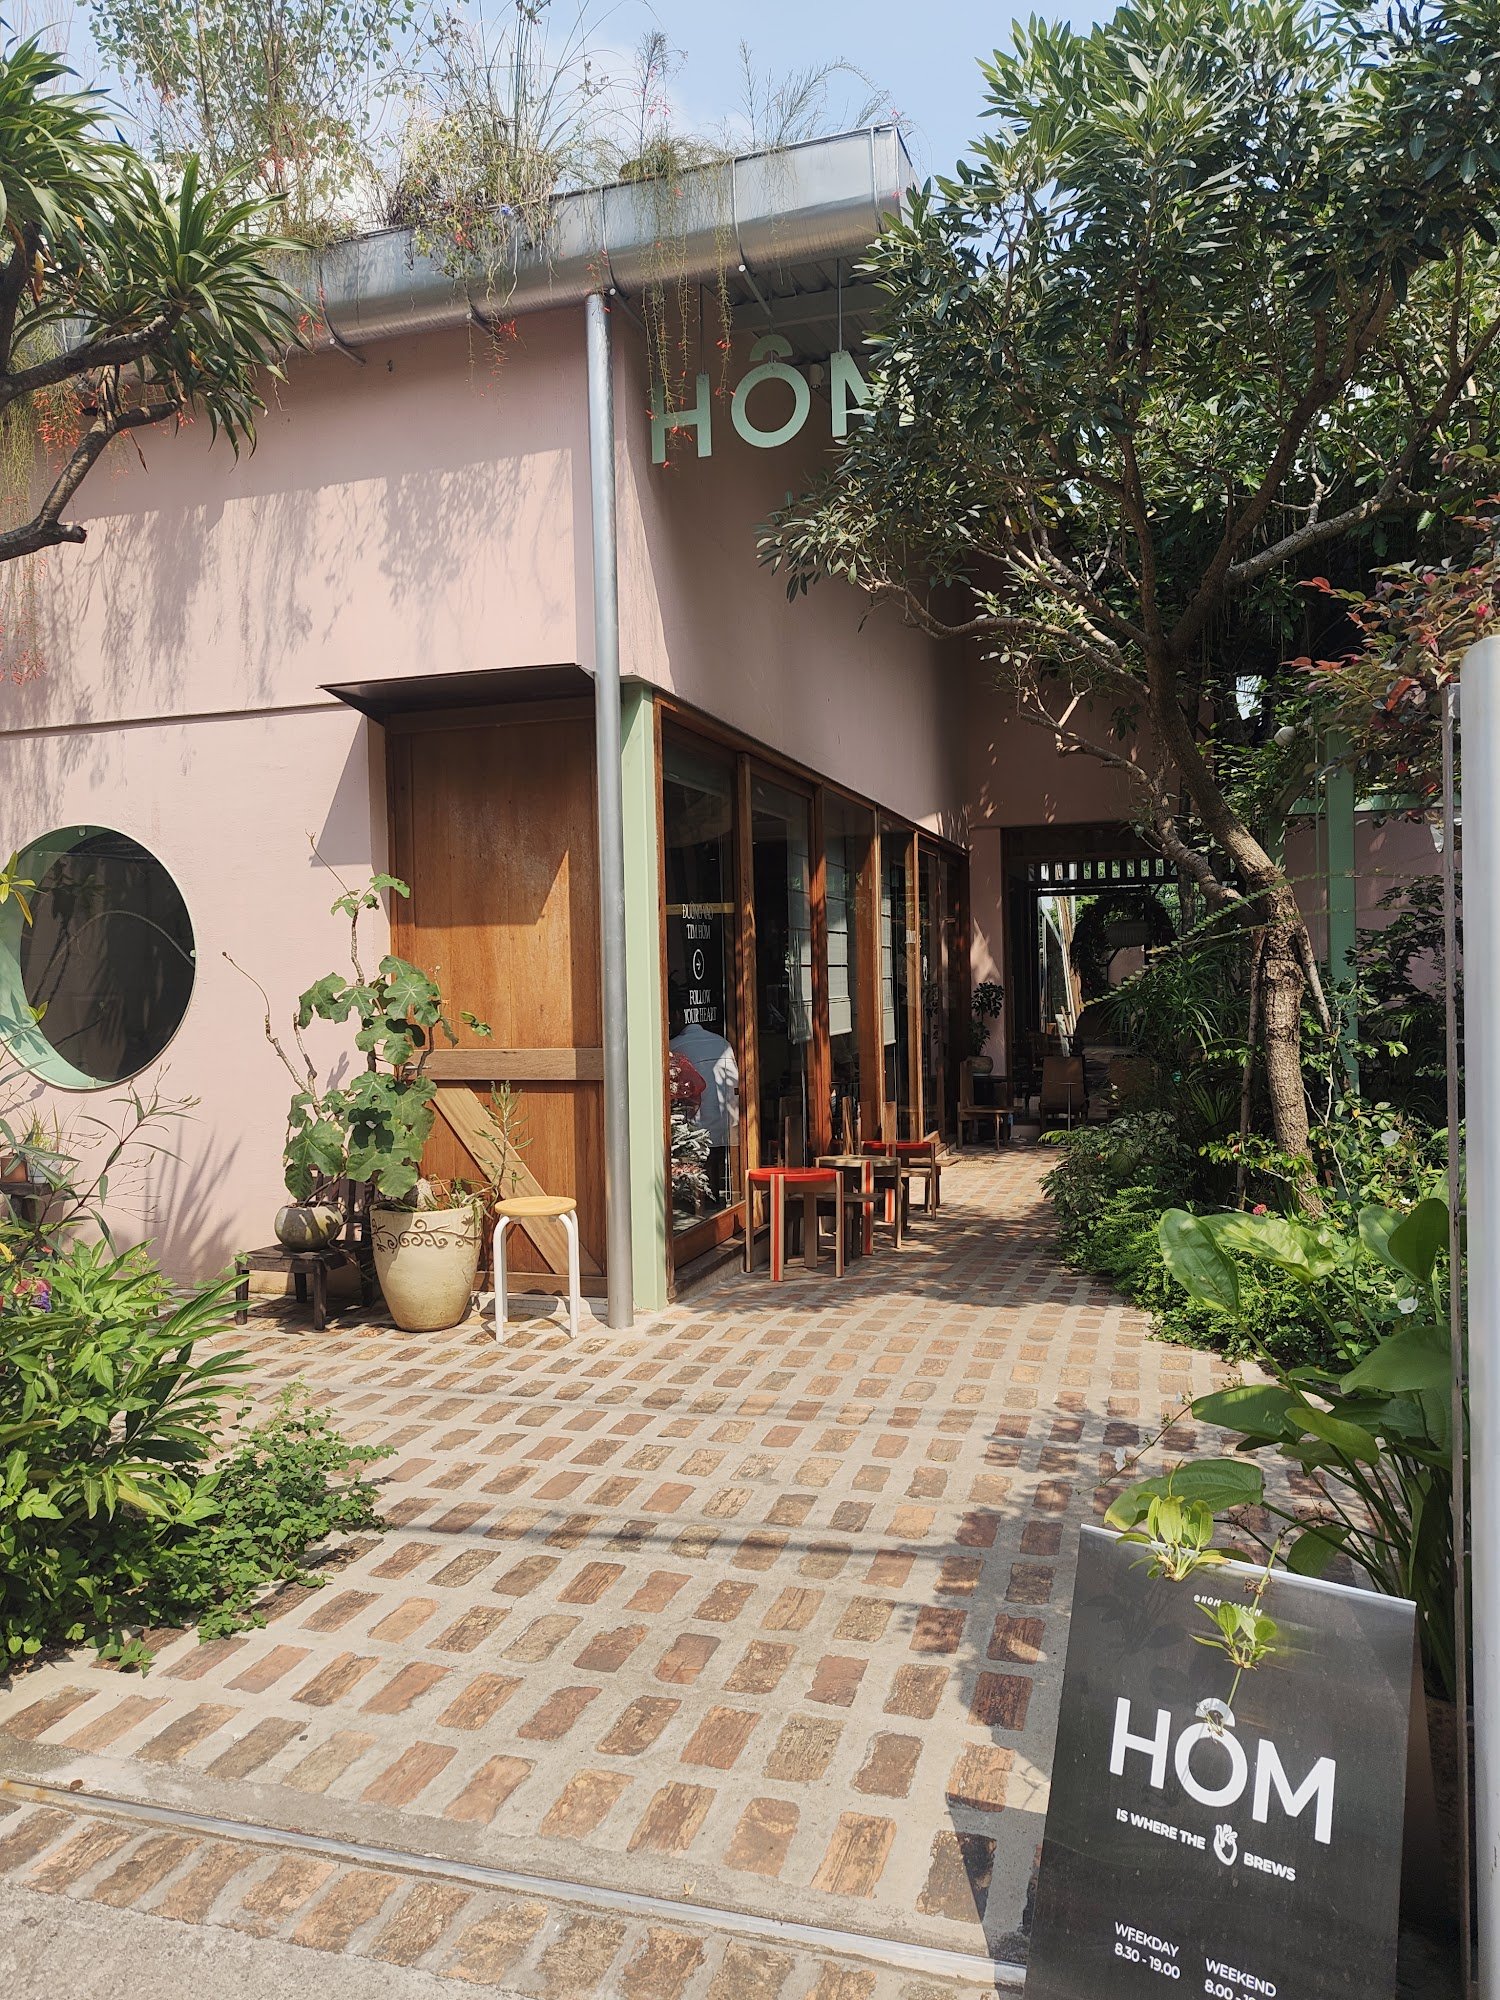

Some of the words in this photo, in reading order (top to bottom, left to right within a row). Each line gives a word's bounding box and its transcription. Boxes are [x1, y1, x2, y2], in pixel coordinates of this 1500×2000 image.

[684, 1008, 700, 1024] YOUR
[700, 1006, 717, 1022] HEART
[689, 989, 711, 1005] FOLLOW
[1116, 1808, 1129, 1823] IS
[1130, 1812, 1177, 1840] WHERE
[1179, 1830, 1206, 1850] THE
[1243, 1851, 1297, 1881] BREWS
[1115, 1921, 1179, 1957] WEEKDAY
[1114, 1942, 1140, 1963] 8.30
[1149, 1955, 1181, 1979] 19.00
[1205, 1957, 1277, 1998] WEEKEND
[1204, 1979, 1234, 2000] 8.00
